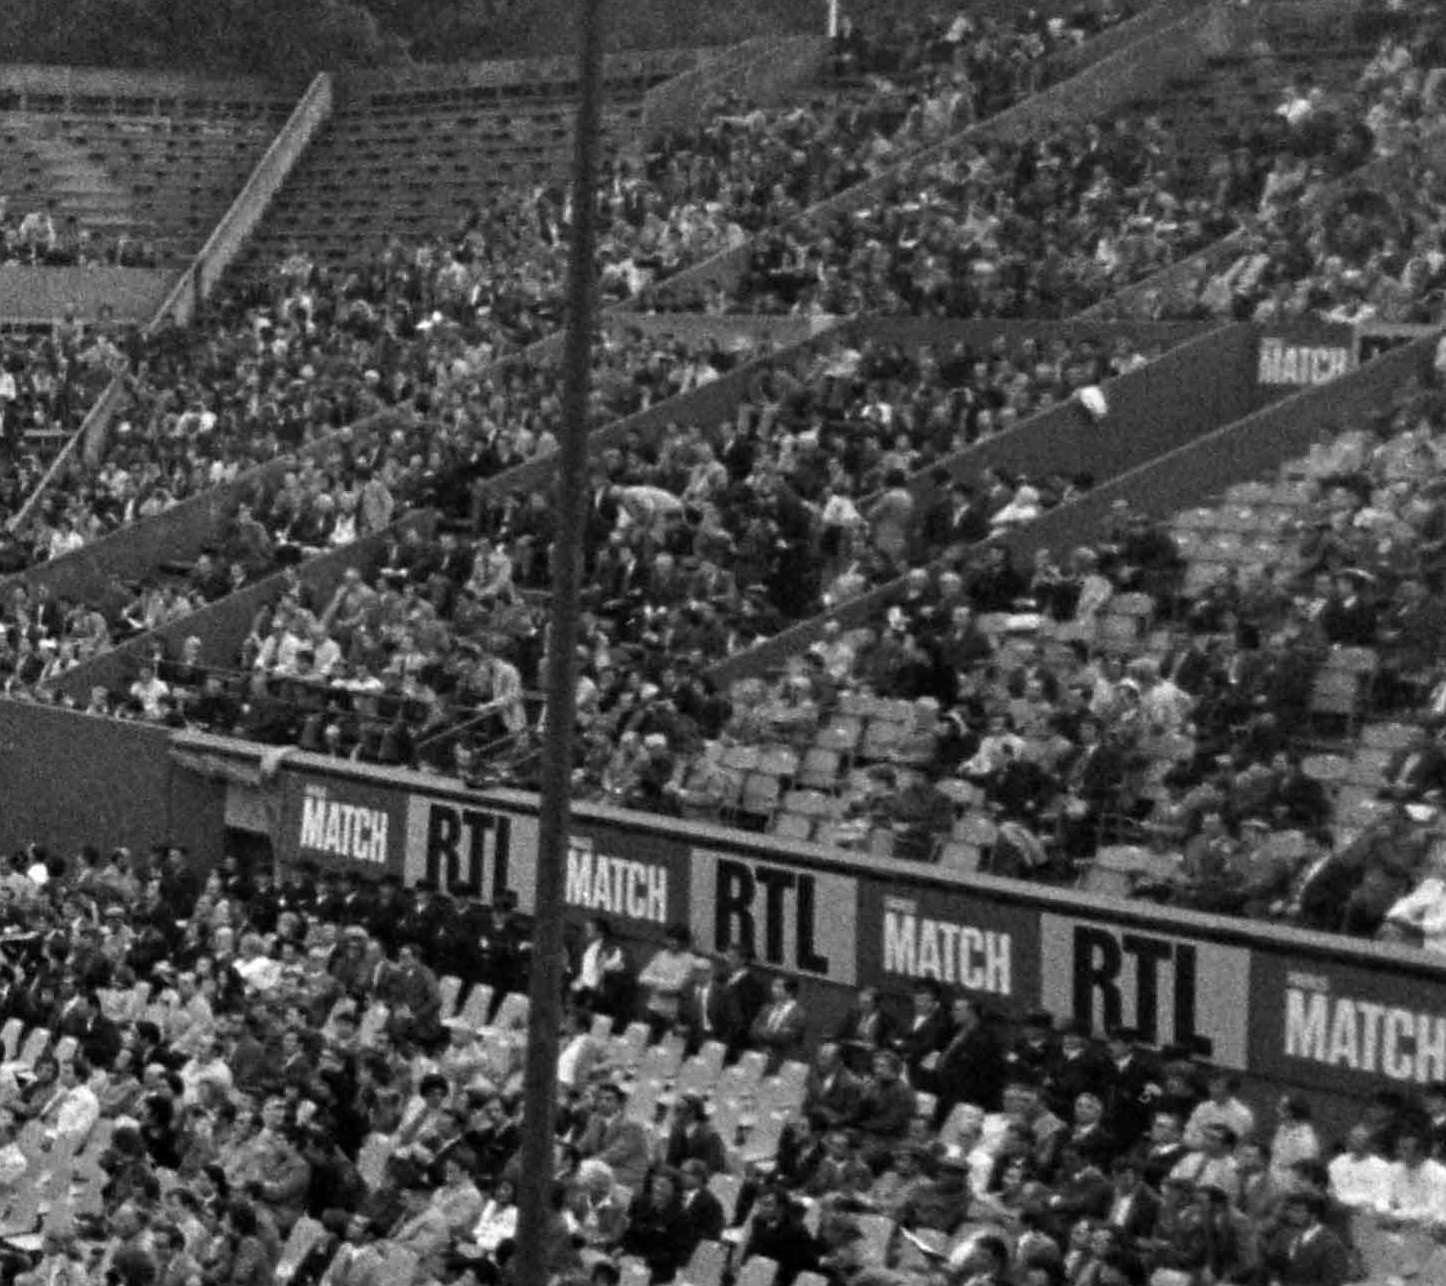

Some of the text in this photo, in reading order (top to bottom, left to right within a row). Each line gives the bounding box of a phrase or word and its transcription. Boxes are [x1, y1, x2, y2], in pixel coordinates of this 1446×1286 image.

[300, 796, 388, 864] MATCH
[426, 803, 519, 909] RTL
[565, 849, 667, 923] MATCH
[715, 858, 829, 974] RTL
[883, 912, 1011, 995] MATCH
[1073, 925, 1213, 1057] RTL
[1285, 988, 1446, 1083] MATCH
